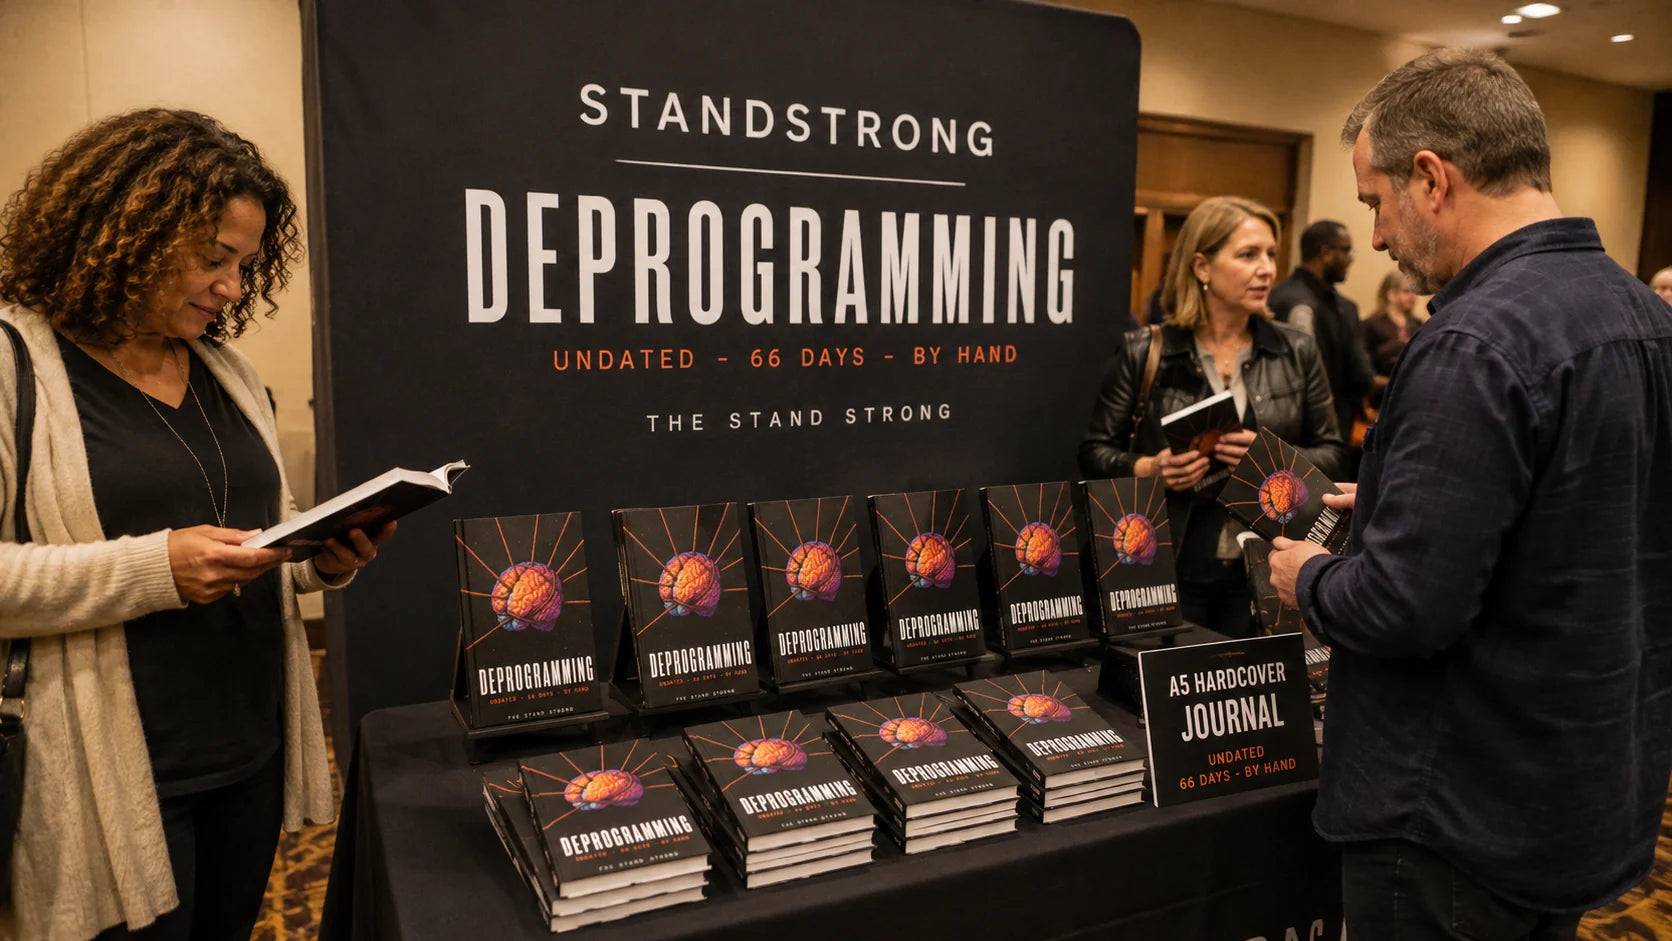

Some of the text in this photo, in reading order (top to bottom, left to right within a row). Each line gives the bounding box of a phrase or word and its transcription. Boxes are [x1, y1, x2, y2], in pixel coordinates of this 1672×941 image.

[580, 84, 993, 157] STANDSTRONG
[465, 188, 1074, 325] DEPROGRAMMING
[554, 349, 693, 371] UNDATED
[751, 348, 780, 368] 66
[801, 347, 864, 366] DAYS
[914, 346, 940, 364] BY
[958, 345, 1016, 363] HAND
[647, 404, 949, 432] THE STAND STRONG
[1010, 595, 1083, 624] DEPROGRAMMING
[1110, 584, 1177, 611] DEPROGRAMMING
[778, 622, 866, 656] DEPROGRAMMING
[899, 609, 980, 640] DEPROGRAMMING
[649, 640, 752, 678] DEPROGRAMMING
[479, 656, 594, 695] DEPROGRAMMING
[1169, 675, 1190, 697] A5
[1194, 662, 1286, 693] HARDCOVER
[1181, 693, 1284, 742] JOURNAL
[1026, 729, 1124, 757] DEPROGRAMMING
[1208, 746, 1264, 766] UNDATED
[892, 754, 999, 785] DEPROGRAMMING
[1179, 776, 1195, 789] 66
[1200, 770, 1230, 786] DAYS
[1245, 764, 1259, 778] BY
[1264, 758, 1296, 773] HAND
[739, 780, 857, 815] DEPROGRAMMING
[560, 815, 693, 857] DEPROGRAMMING
